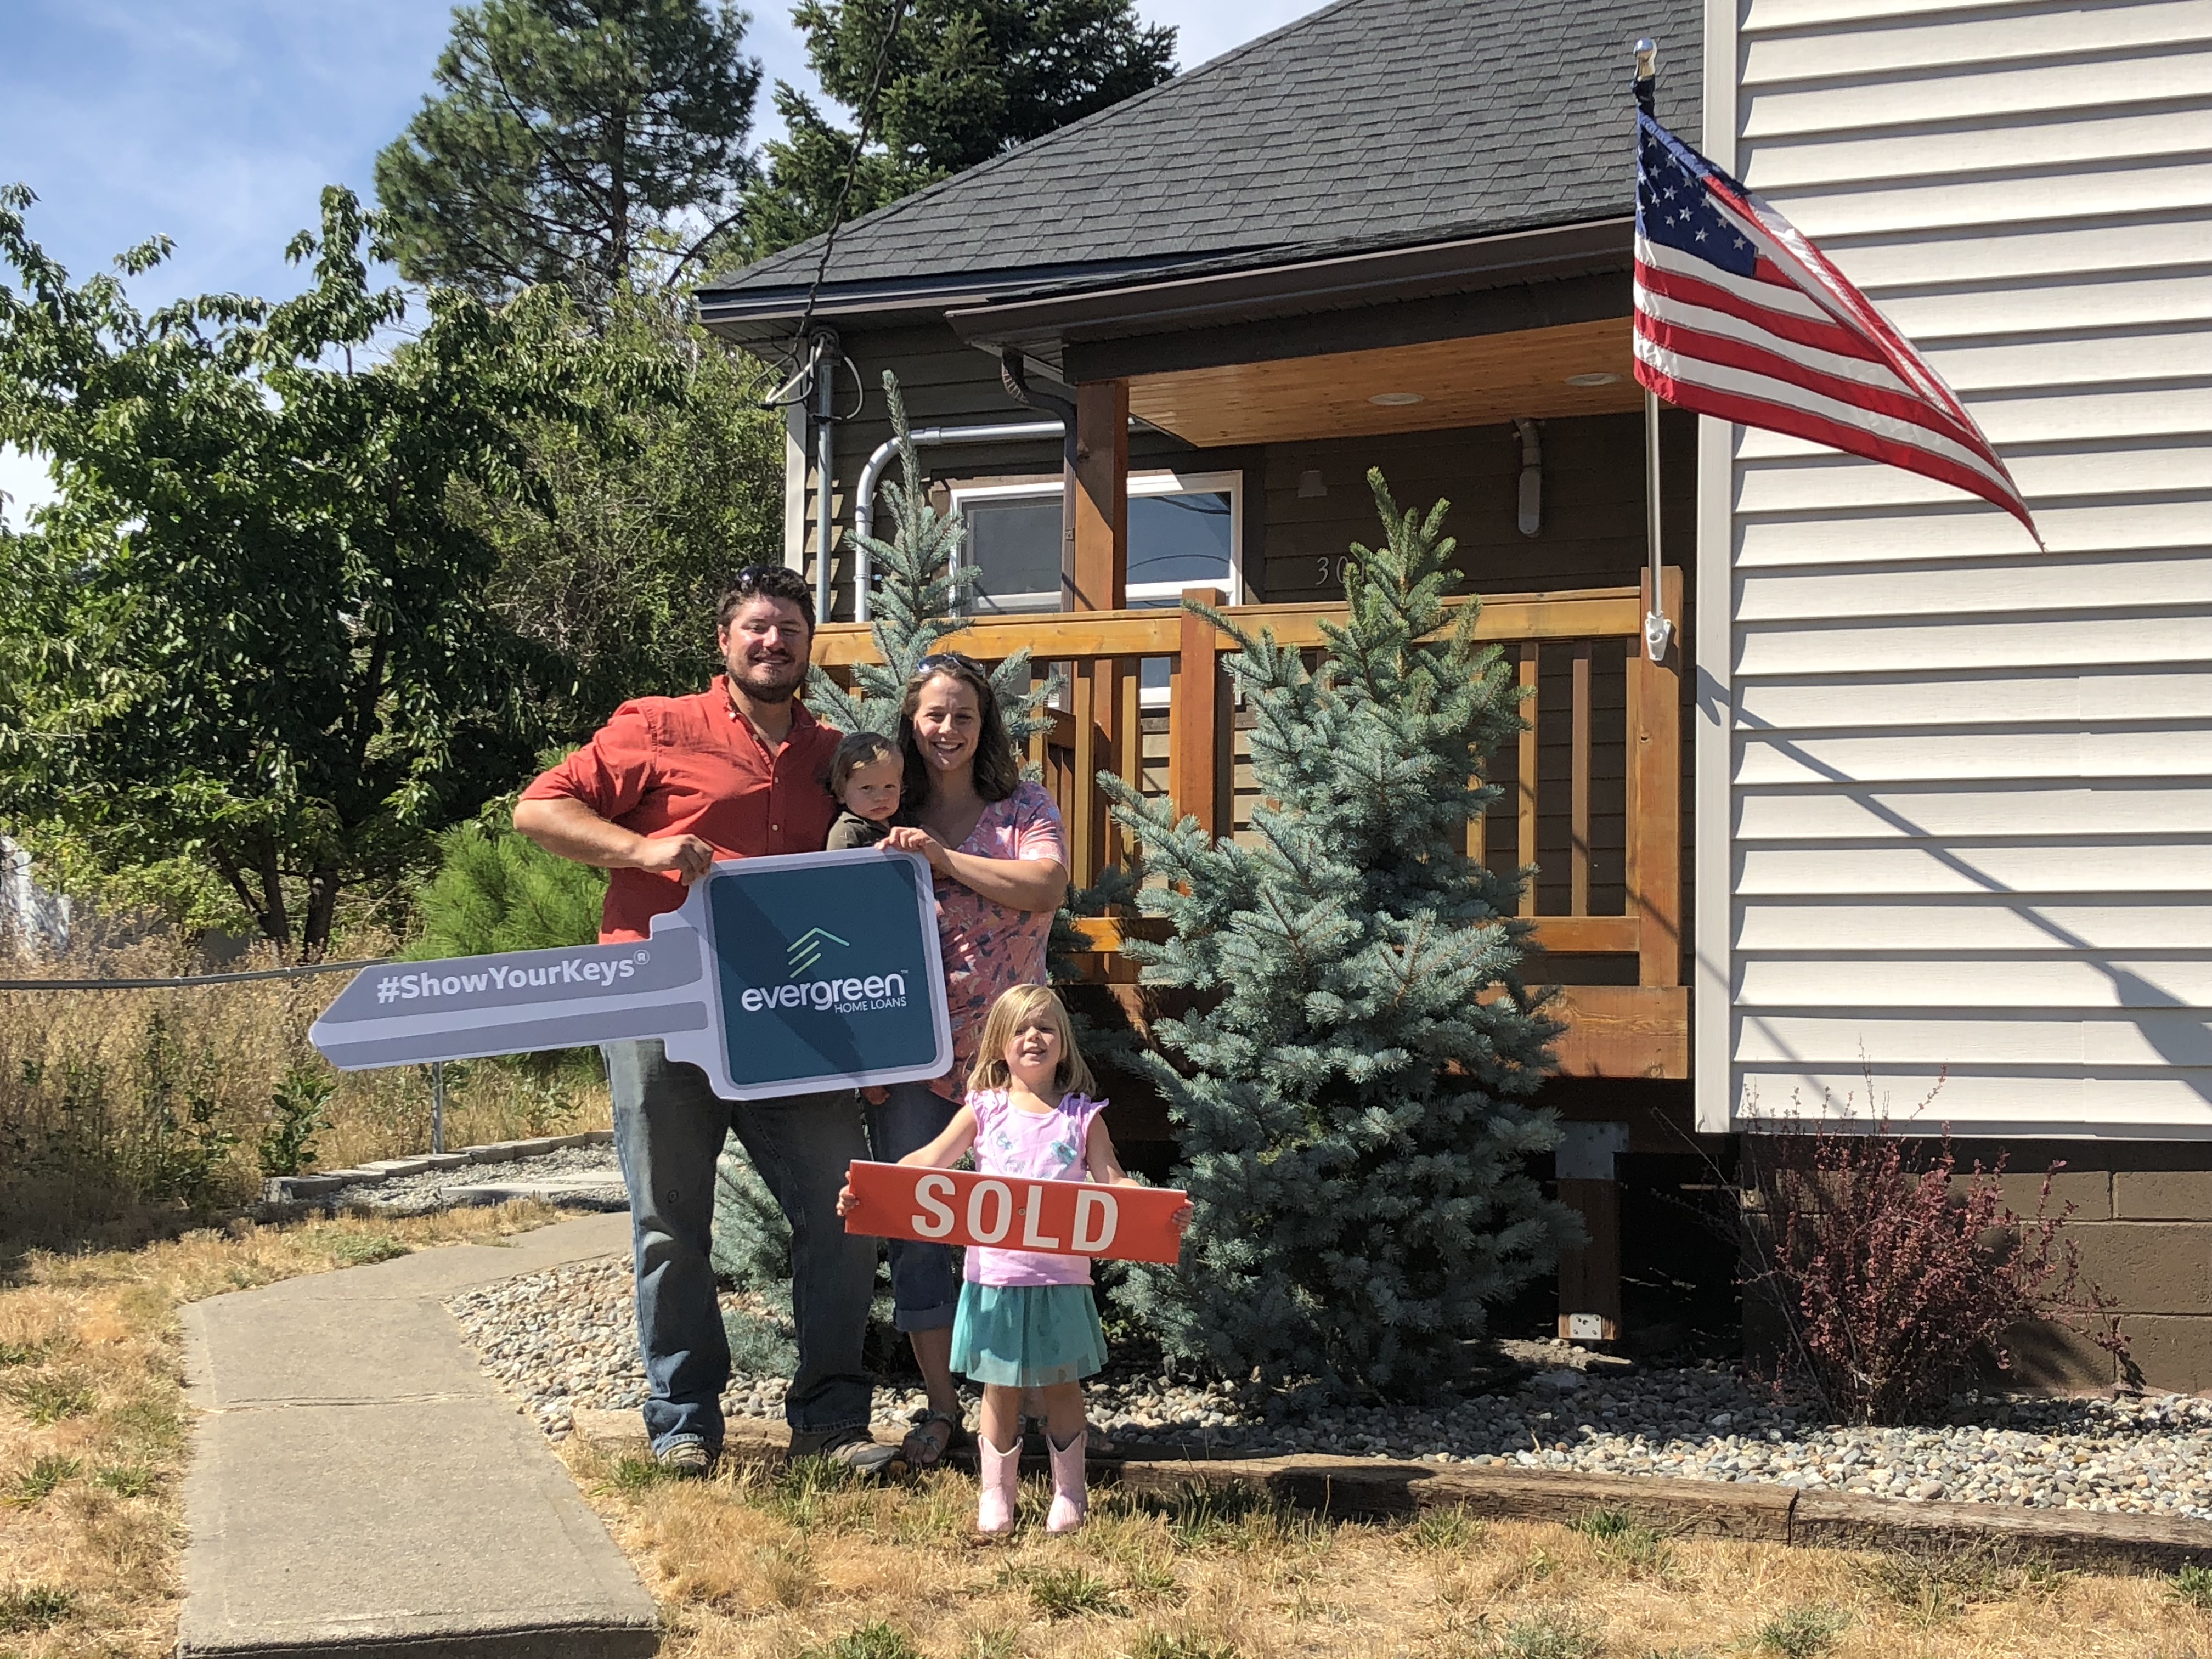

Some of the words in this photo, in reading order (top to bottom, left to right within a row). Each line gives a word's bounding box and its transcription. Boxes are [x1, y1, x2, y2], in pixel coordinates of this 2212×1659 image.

[834, 1001, 868, 1013] HOME
[871, 996, 907, 1010] LOANS
[911, 1174, 1118, 1252] SOLD
